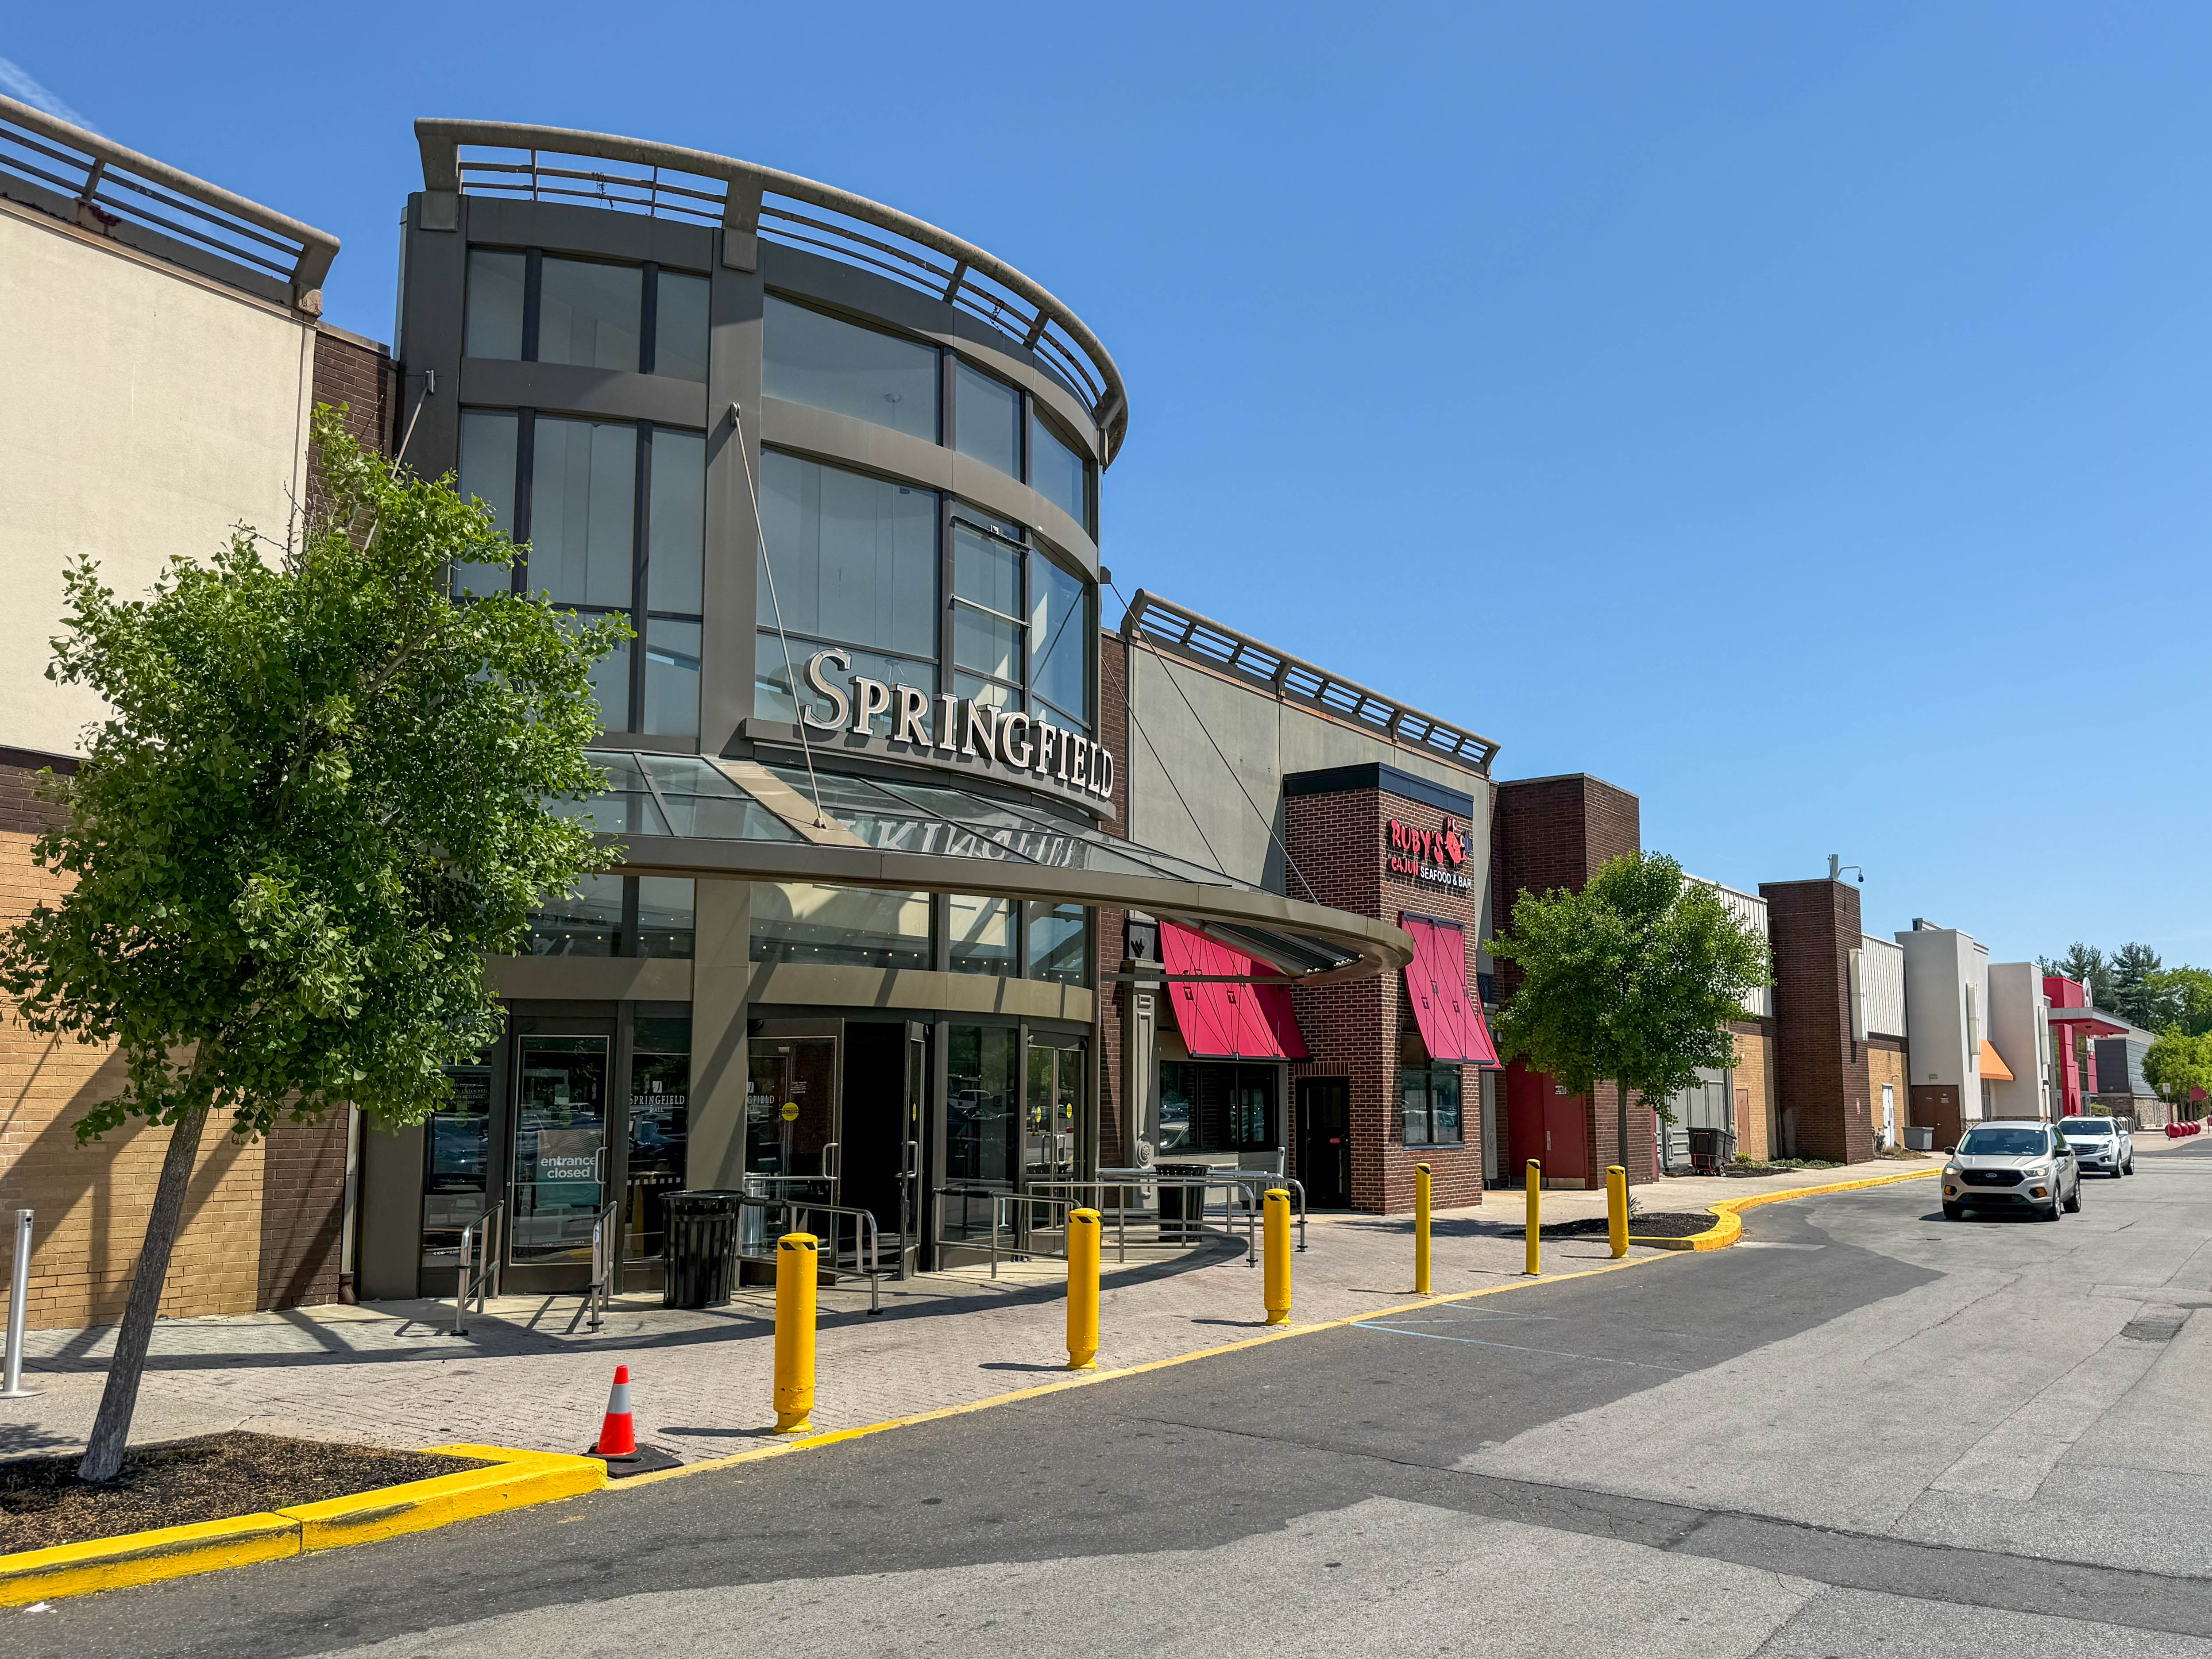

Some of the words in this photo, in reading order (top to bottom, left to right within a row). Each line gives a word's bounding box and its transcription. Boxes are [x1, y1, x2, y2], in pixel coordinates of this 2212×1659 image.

[803, 648, 1115, 798] SPRINGFIELD
[1390, 818, 1444, 864] RUBY'S
[1391, 857, 1419, 876] CAJUN
[1420, 866, 1452, 884] SEAFOOD
[1452, 874, 1457, 886] &
[1458, 877, 1471, 889] BAR
[629, 1093, 685, 1105] SPRINGFIELD
[540, 1156, 596, 1166] entrance
[547, 1167, 590, 1178] closed
